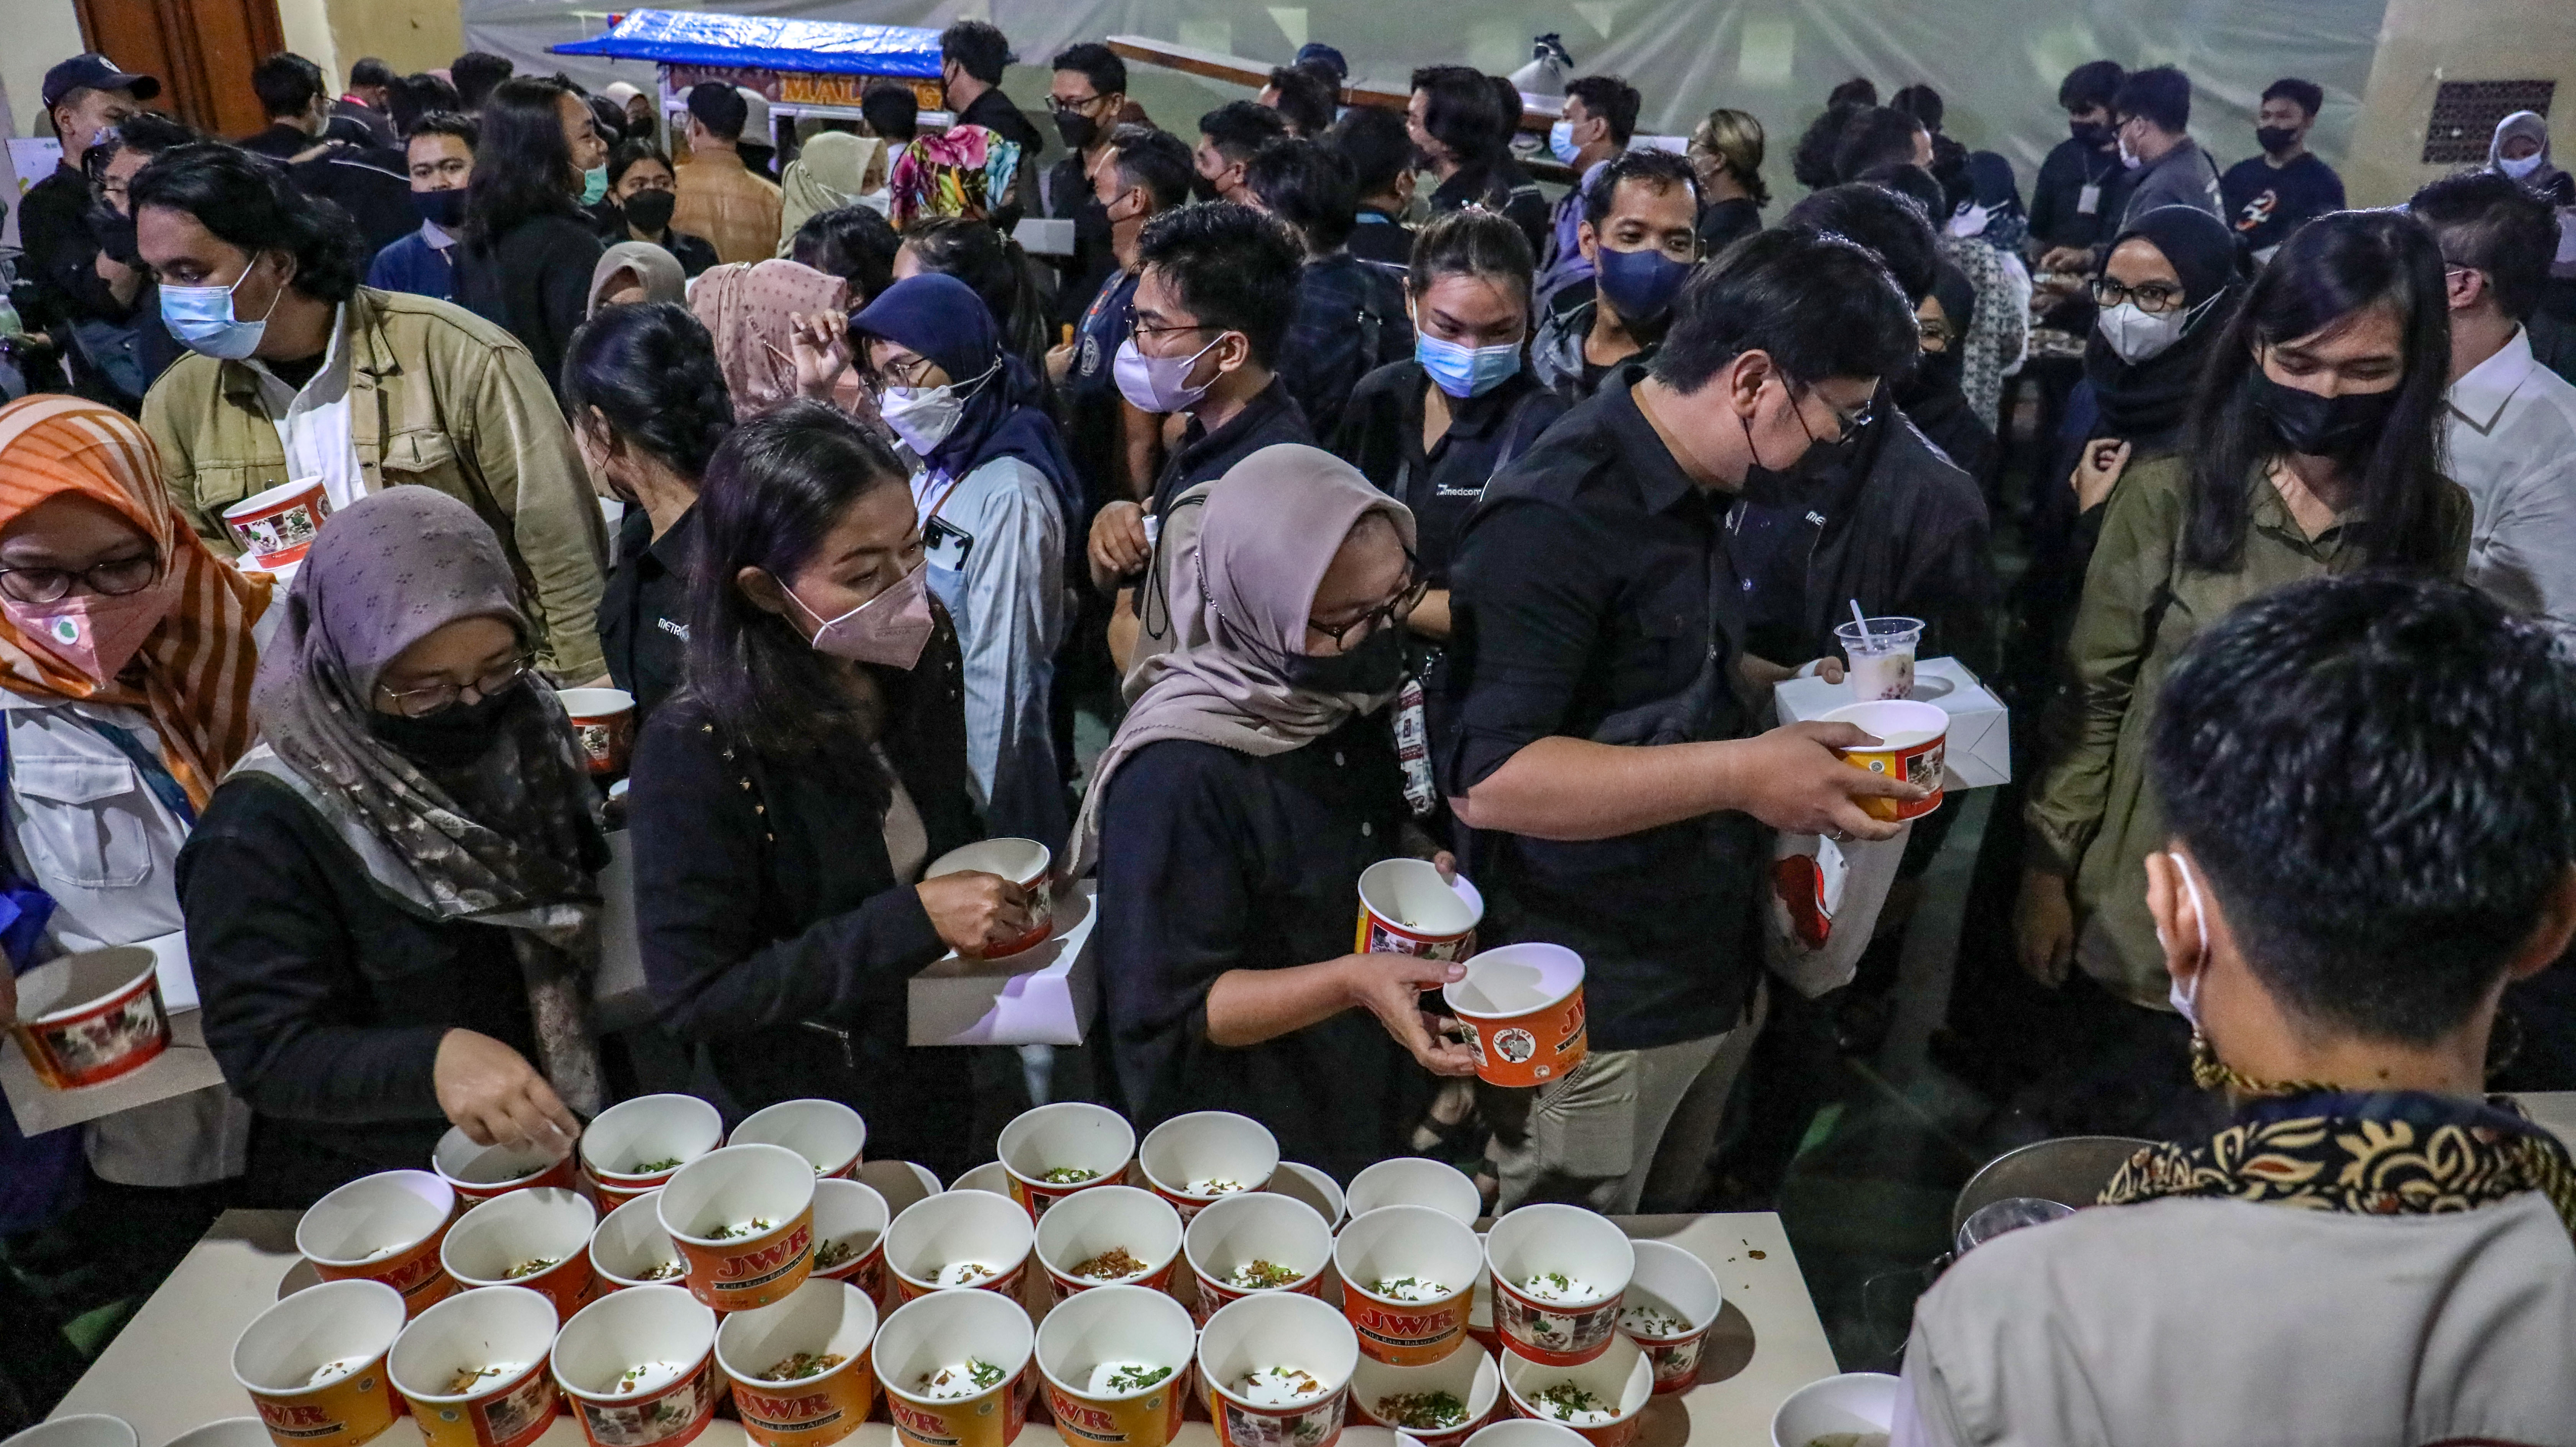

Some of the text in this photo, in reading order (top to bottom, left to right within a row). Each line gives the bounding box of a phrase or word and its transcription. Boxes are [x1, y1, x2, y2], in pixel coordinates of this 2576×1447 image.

[781, 77, 943, 112] MALG
[716, 1224, 810, 1278] JWR
[1361, 1308, 1455, 1335] JWR
[1364, 1329, 1379, 1339] Cita
[1382, 1336, 1401, 1345] Rasa
[736, 1388, 834, 1419] JWR
